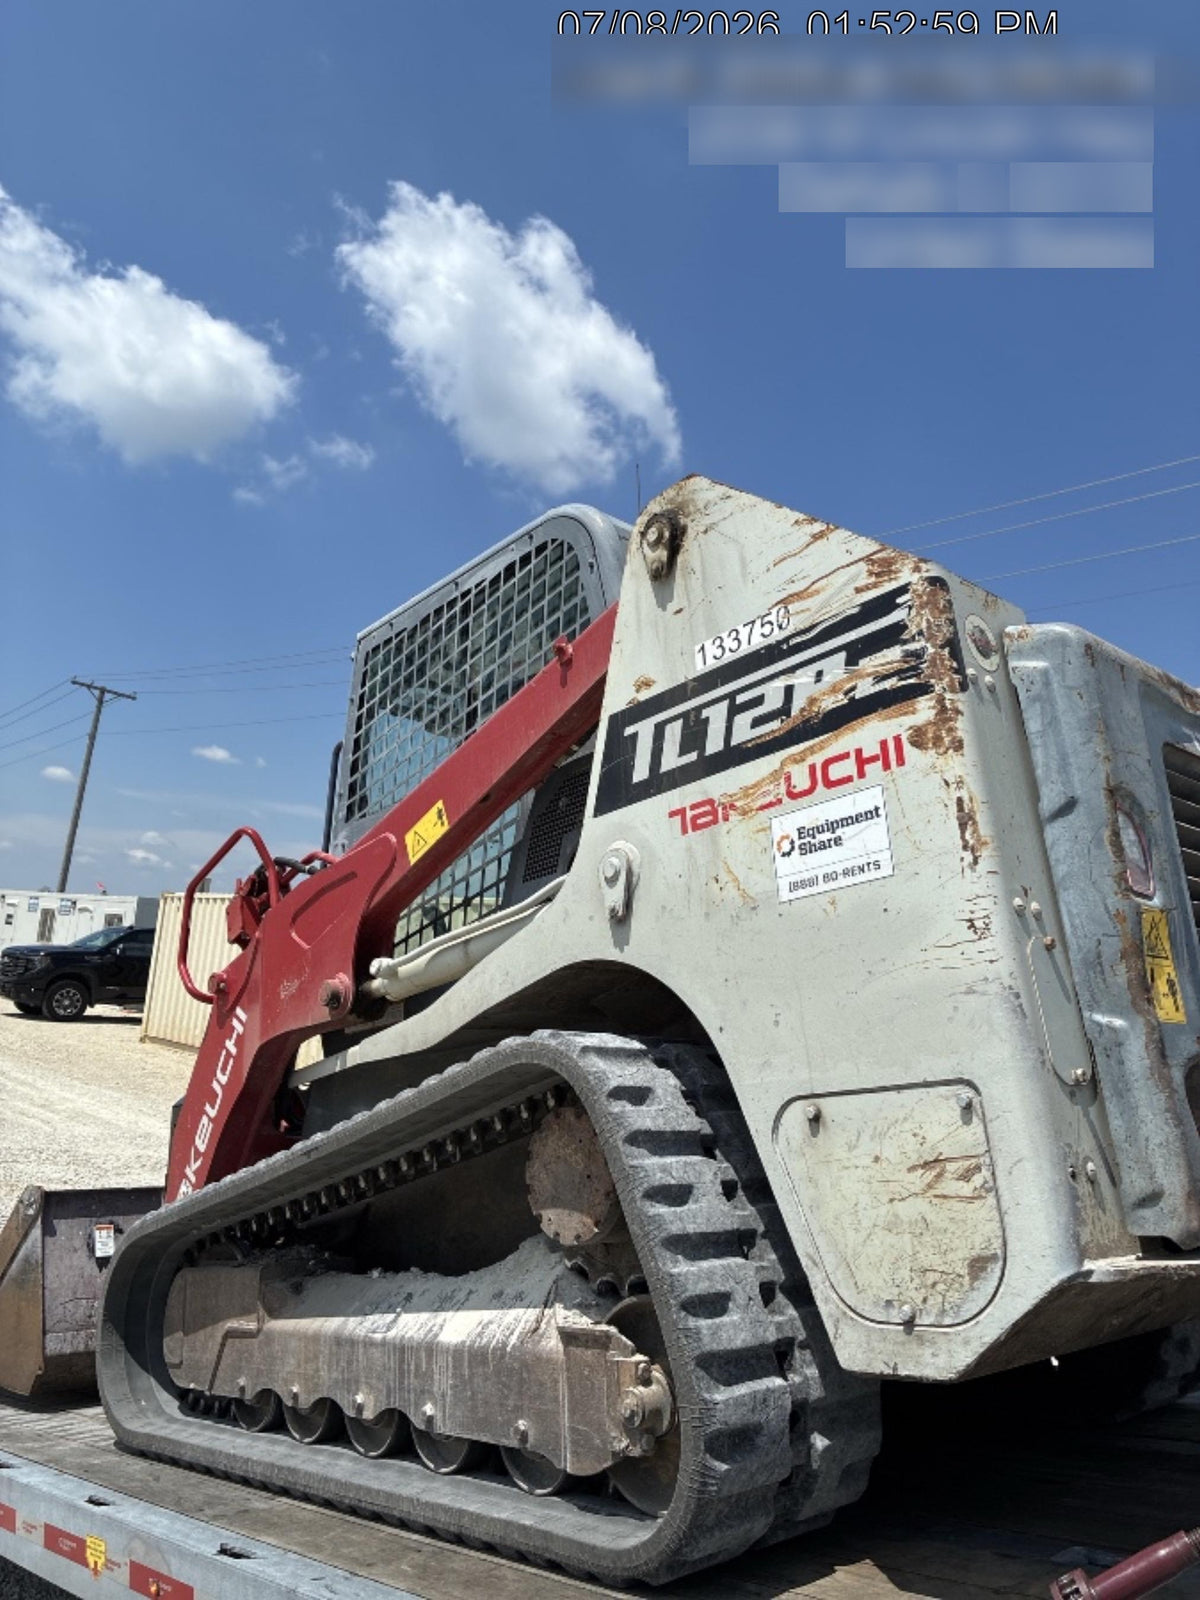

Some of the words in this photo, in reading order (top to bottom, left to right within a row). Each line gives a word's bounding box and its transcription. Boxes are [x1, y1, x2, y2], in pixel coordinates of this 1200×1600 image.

[697, 606, 790, 665] 133750
[796, 805, 881, 839] Equipment
[798, 835, 843, 856] Share
